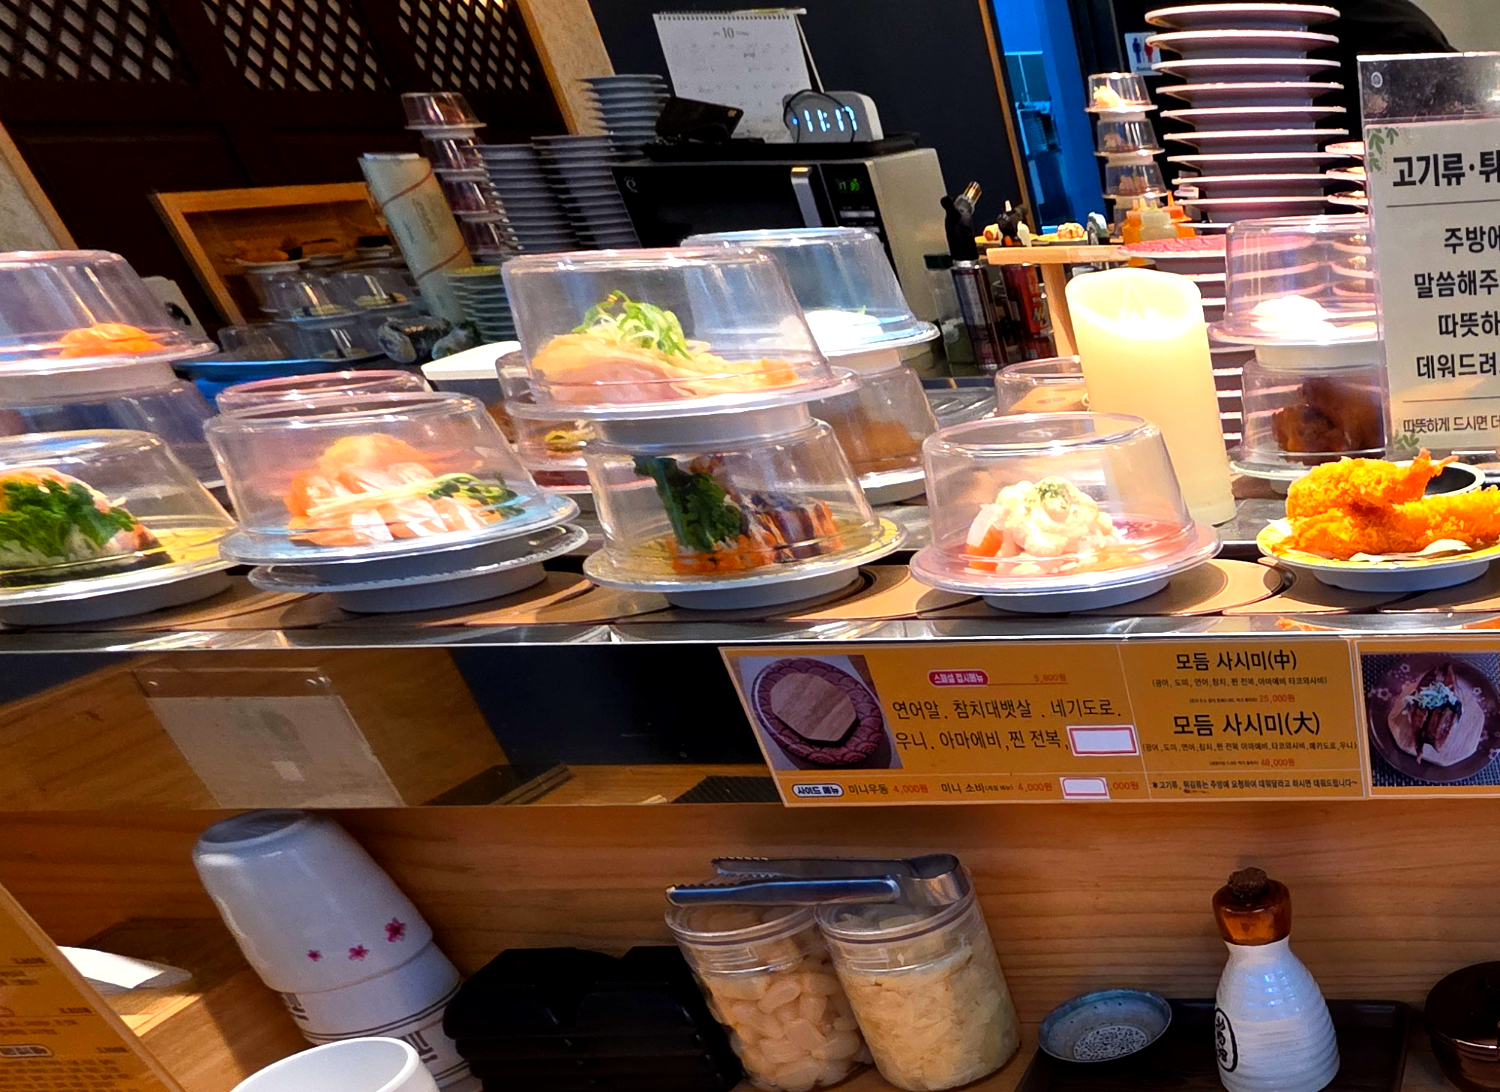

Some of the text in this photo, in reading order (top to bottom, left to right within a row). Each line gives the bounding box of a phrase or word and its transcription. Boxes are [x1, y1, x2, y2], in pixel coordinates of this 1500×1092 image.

[1403, 417, 1450, 434] 따뜻하게
[1453, 415, 1488, 431] 드시면
[1176, 649, 1297, 671] 모듬 사시미(中)
[893, 698, 1122, 720] 연어알. 참치대뱃살 네기도로.
[1173, 711, 1321, 736] 모듬 사시미(大)
[896, 730, 935, 750] 우니.
[849, 783, 889, 795] 미니우동
[941, 783, 962, 794] 미니
[1109, 781, 1139, 791] ,000원
